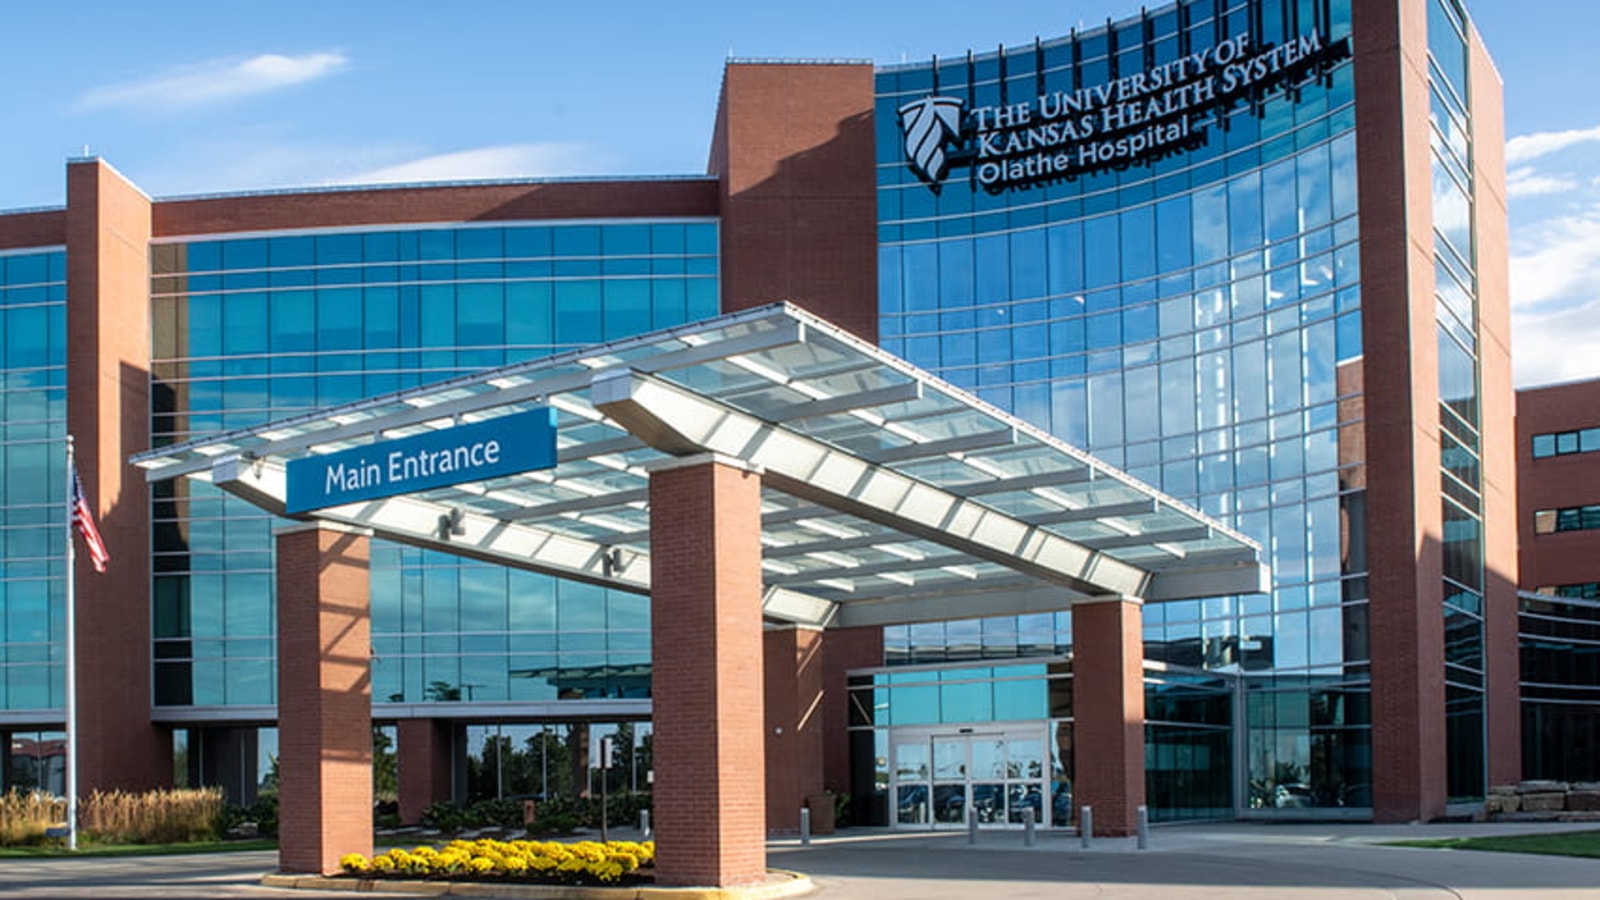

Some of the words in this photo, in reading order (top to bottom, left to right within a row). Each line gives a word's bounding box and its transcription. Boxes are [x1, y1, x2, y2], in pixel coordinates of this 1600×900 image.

[970, 101, 1031, 132] THE
[1039, 49, 1208, 120] UNIVERSITY
[1214, 33, 1251, 66] OF
[977, 116, 1093, 158] KANSAS
[1101, 85, 1216, 133] HEALTH
[1222, 28, 1324, 91] SYSTEM
[978, 146, 1069, 184] Olathe
[1079, 114, 1189, 167] Hospital
[325, 459, 381, 494] Main
[388, 440, 500, 482] Entrance
